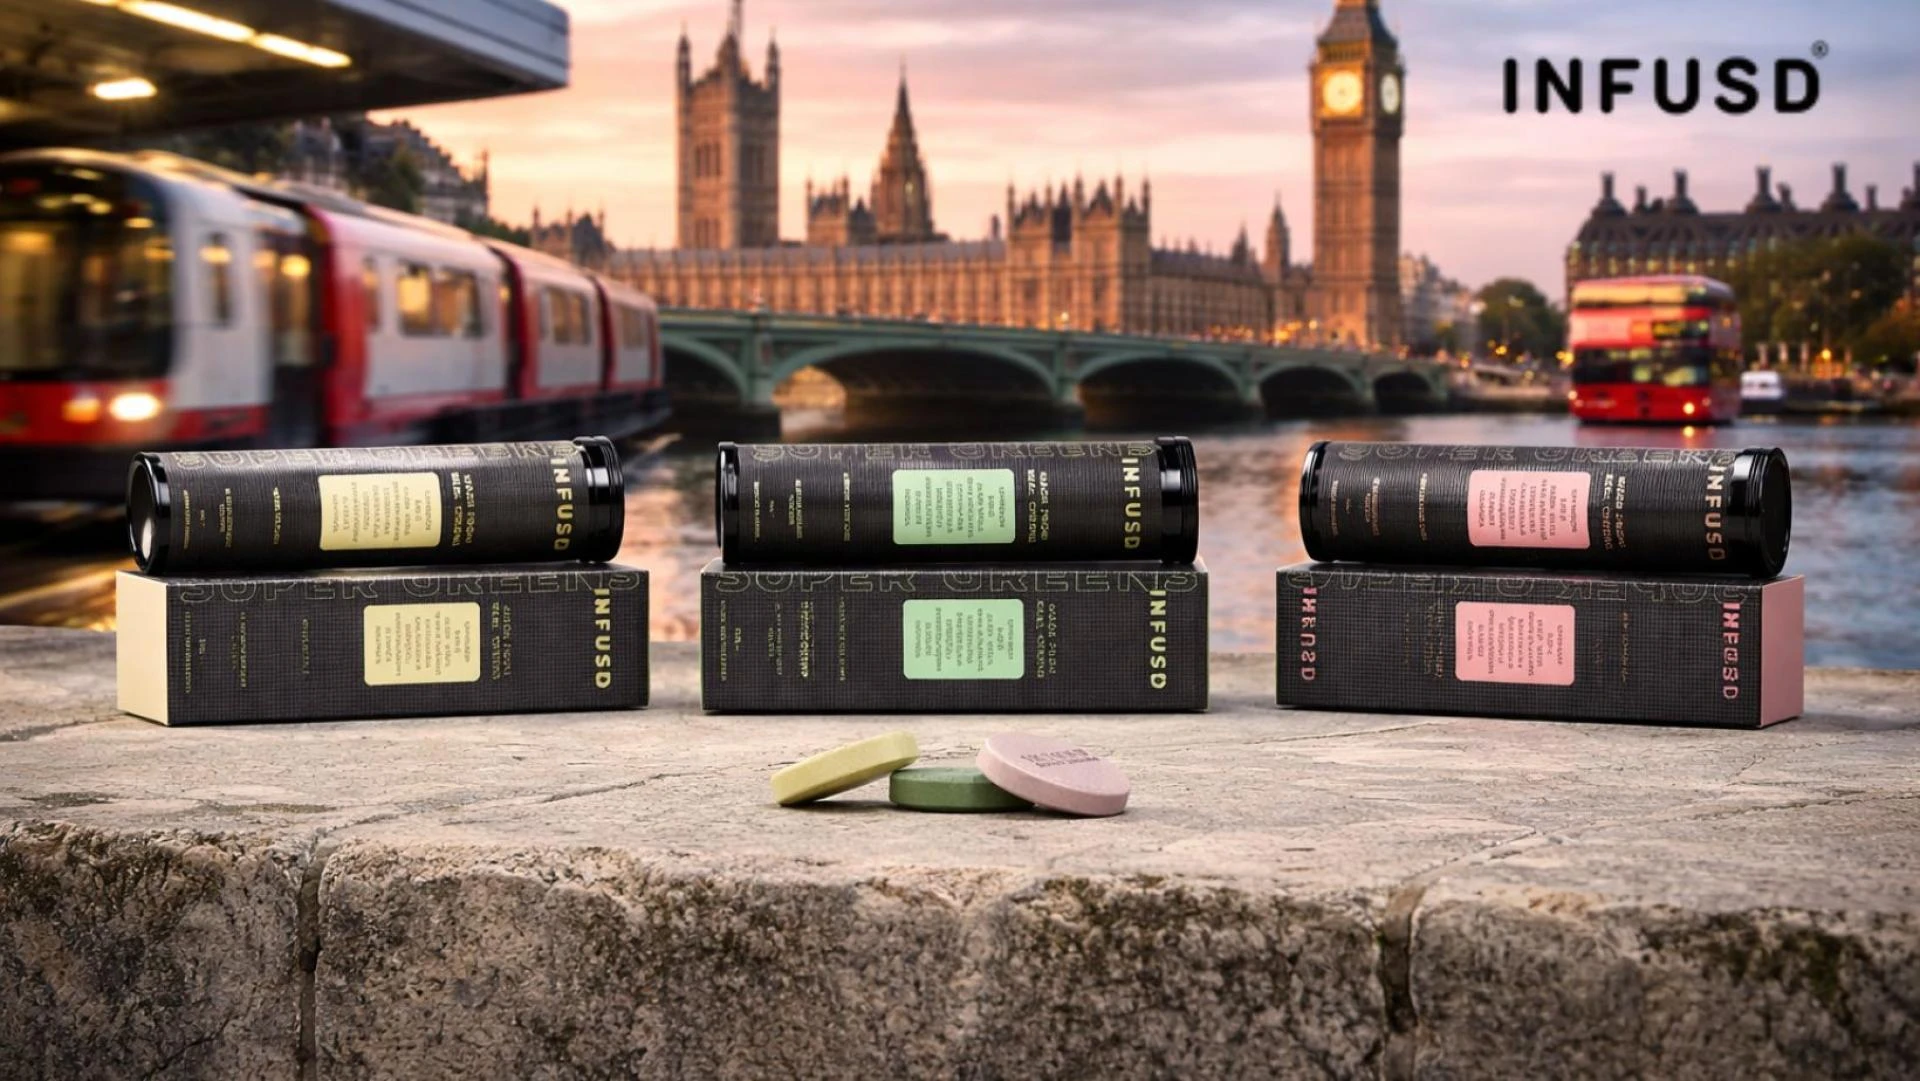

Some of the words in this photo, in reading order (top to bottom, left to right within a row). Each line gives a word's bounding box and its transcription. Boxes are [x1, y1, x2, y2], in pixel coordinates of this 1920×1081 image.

[551, 457, 573, 550] INFUSD
[1122, 457, 1141, 550] INFUSD
[1705, 465, 1726, 561] INFUSD
[594, 587, 612, 689] INFUSD
[1149, 589, 1168, 689] INFUSD
